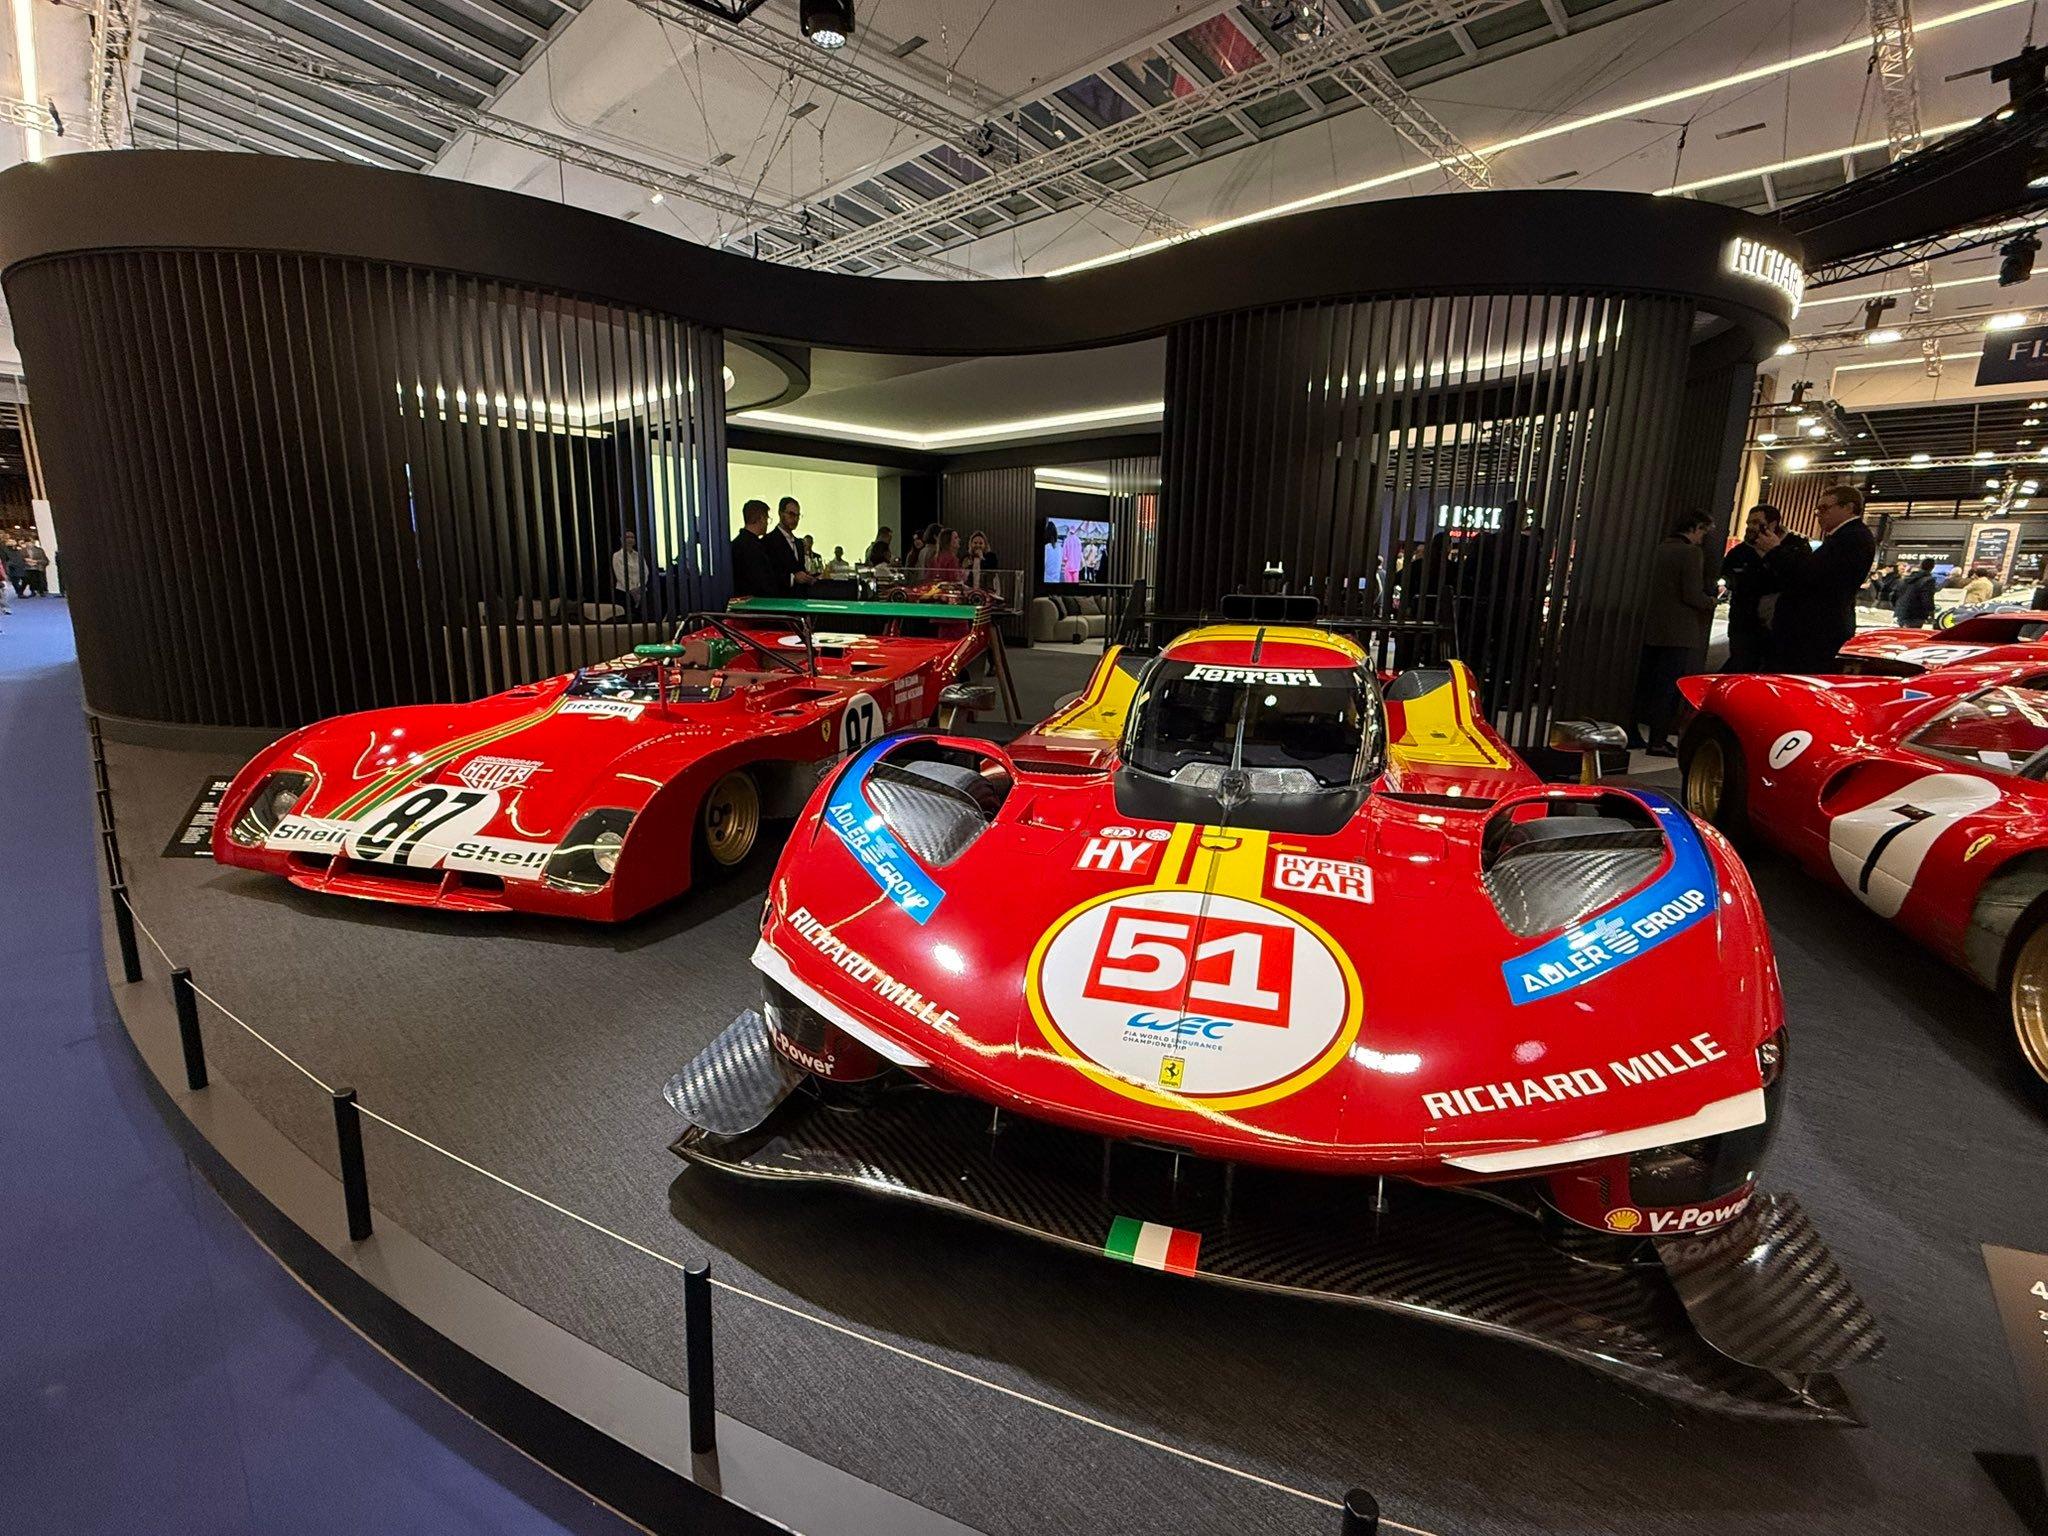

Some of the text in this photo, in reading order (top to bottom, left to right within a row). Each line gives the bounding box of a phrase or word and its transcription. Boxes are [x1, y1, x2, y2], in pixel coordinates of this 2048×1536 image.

[1184, 663, 1322, 687] Ferrari
[1775, 737, 1799, 759] P
[461, 761, 533, 790] HEUER
[273, 823, 351, 843] Shell
[355, 788, 488, 864] 87
[450, 842, 548, 869] Shell
[829, 801, 930, 908] ADLER GROUP
[1077, 838, 1153, 871] HY
[1282, 857, 1365, 879] HYPER
[1281, 868, 1365, 898] CAR
[1520, 889, 1705, 993] ADLER GROUP
[787, 906, 960, 1034] RICHARD MILLE
[1098, 917, 1279, 1011] 51
[1126, 1012, 1234, 1040] WEC
[1122, 1036, 1187, 1051] CHAMPIONSHIP
[1139, 1033, 1169, 1042] WORLD
[1171, 1037, 1223, 1052] ENDURANCE
[1421, 1032, 1727, 1120] RICHARD MILLE
[1649, 1193, 1752, 1232] V-Powe
